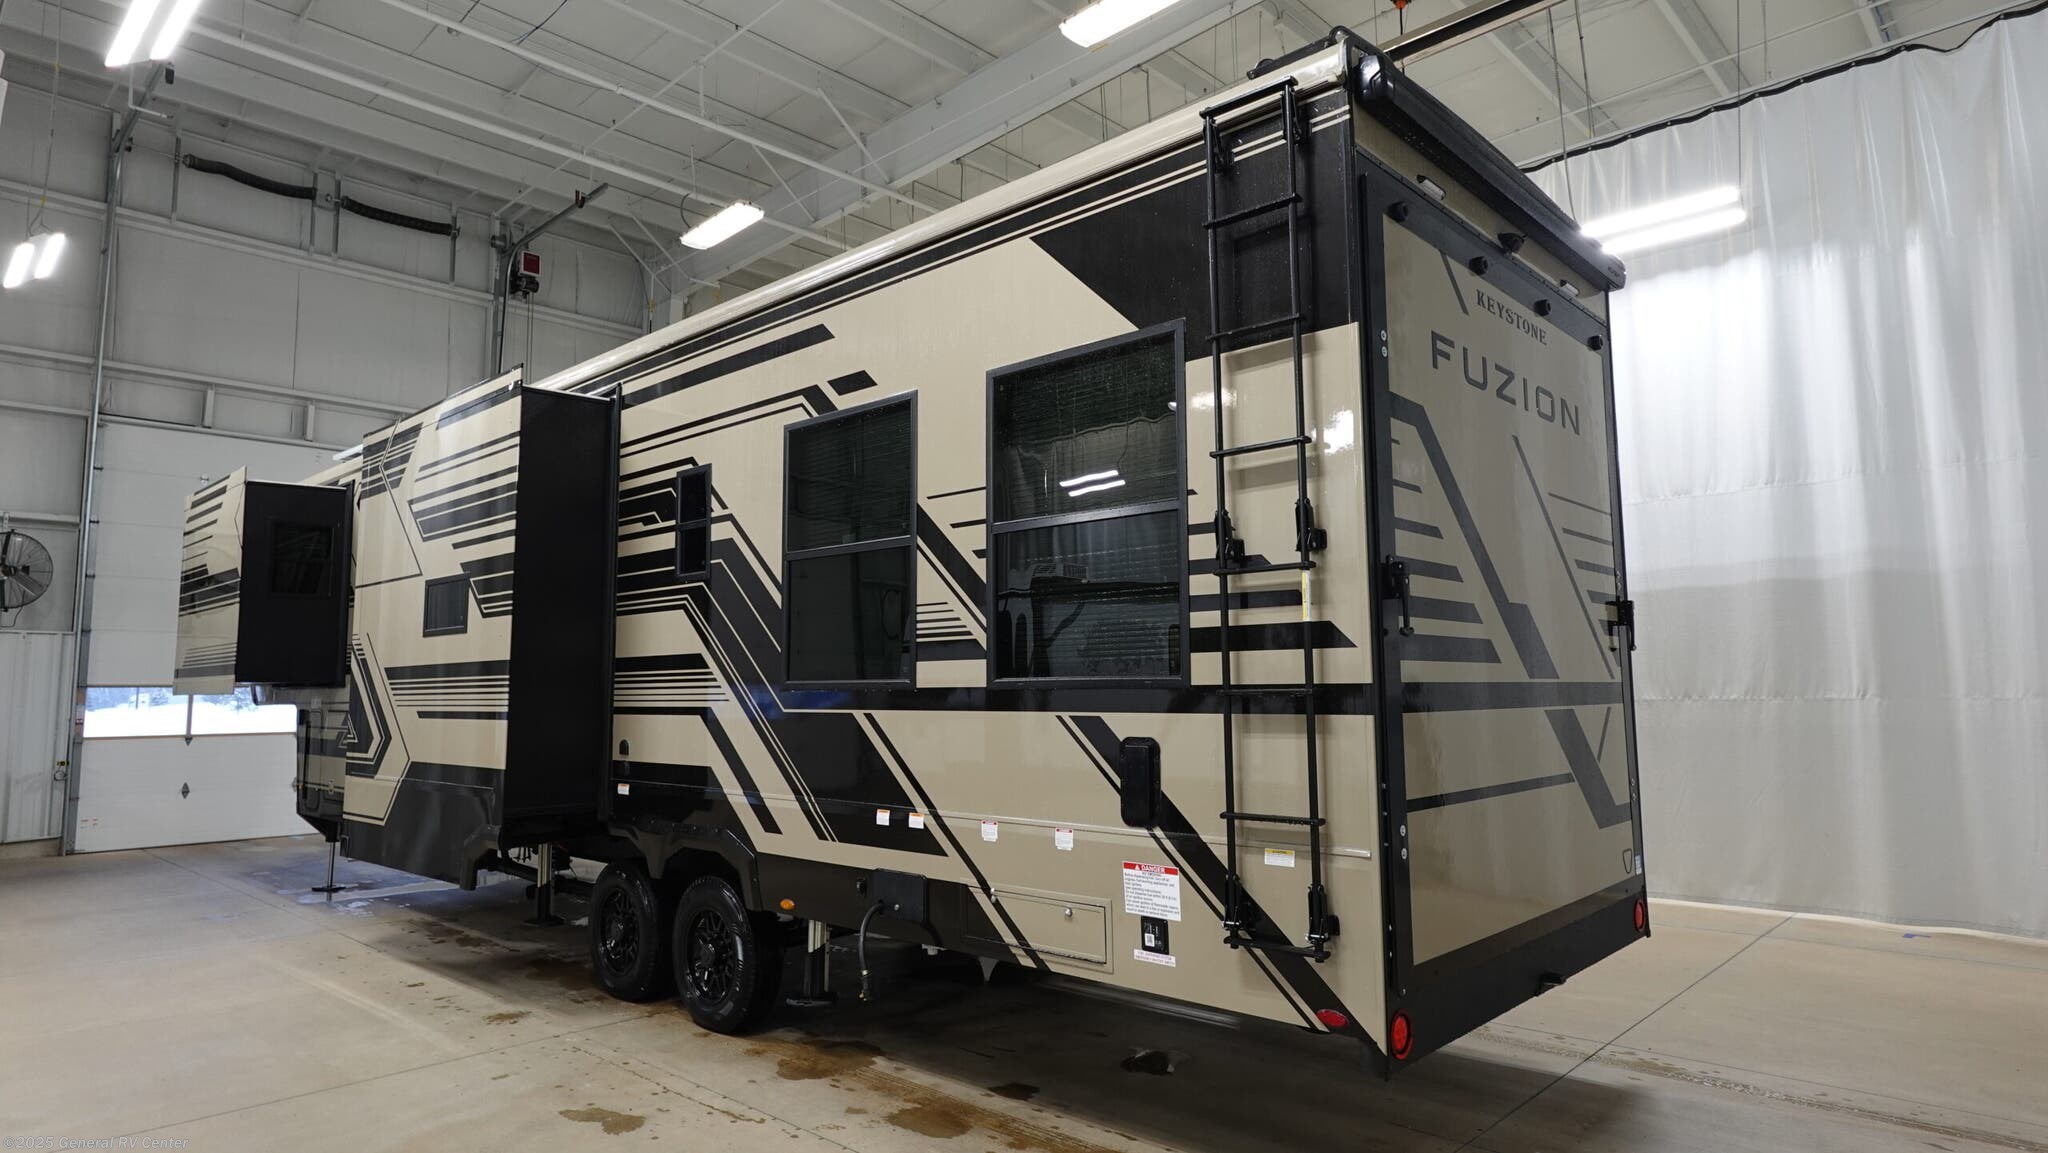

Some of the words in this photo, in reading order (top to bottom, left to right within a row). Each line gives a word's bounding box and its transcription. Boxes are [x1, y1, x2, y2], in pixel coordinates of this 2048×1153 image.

[1476, 289, 1547, 346] KEYSTONE
[1431, 330, 1580, 435] FUZION
[1141, 864, 1165, 874] DANGER
